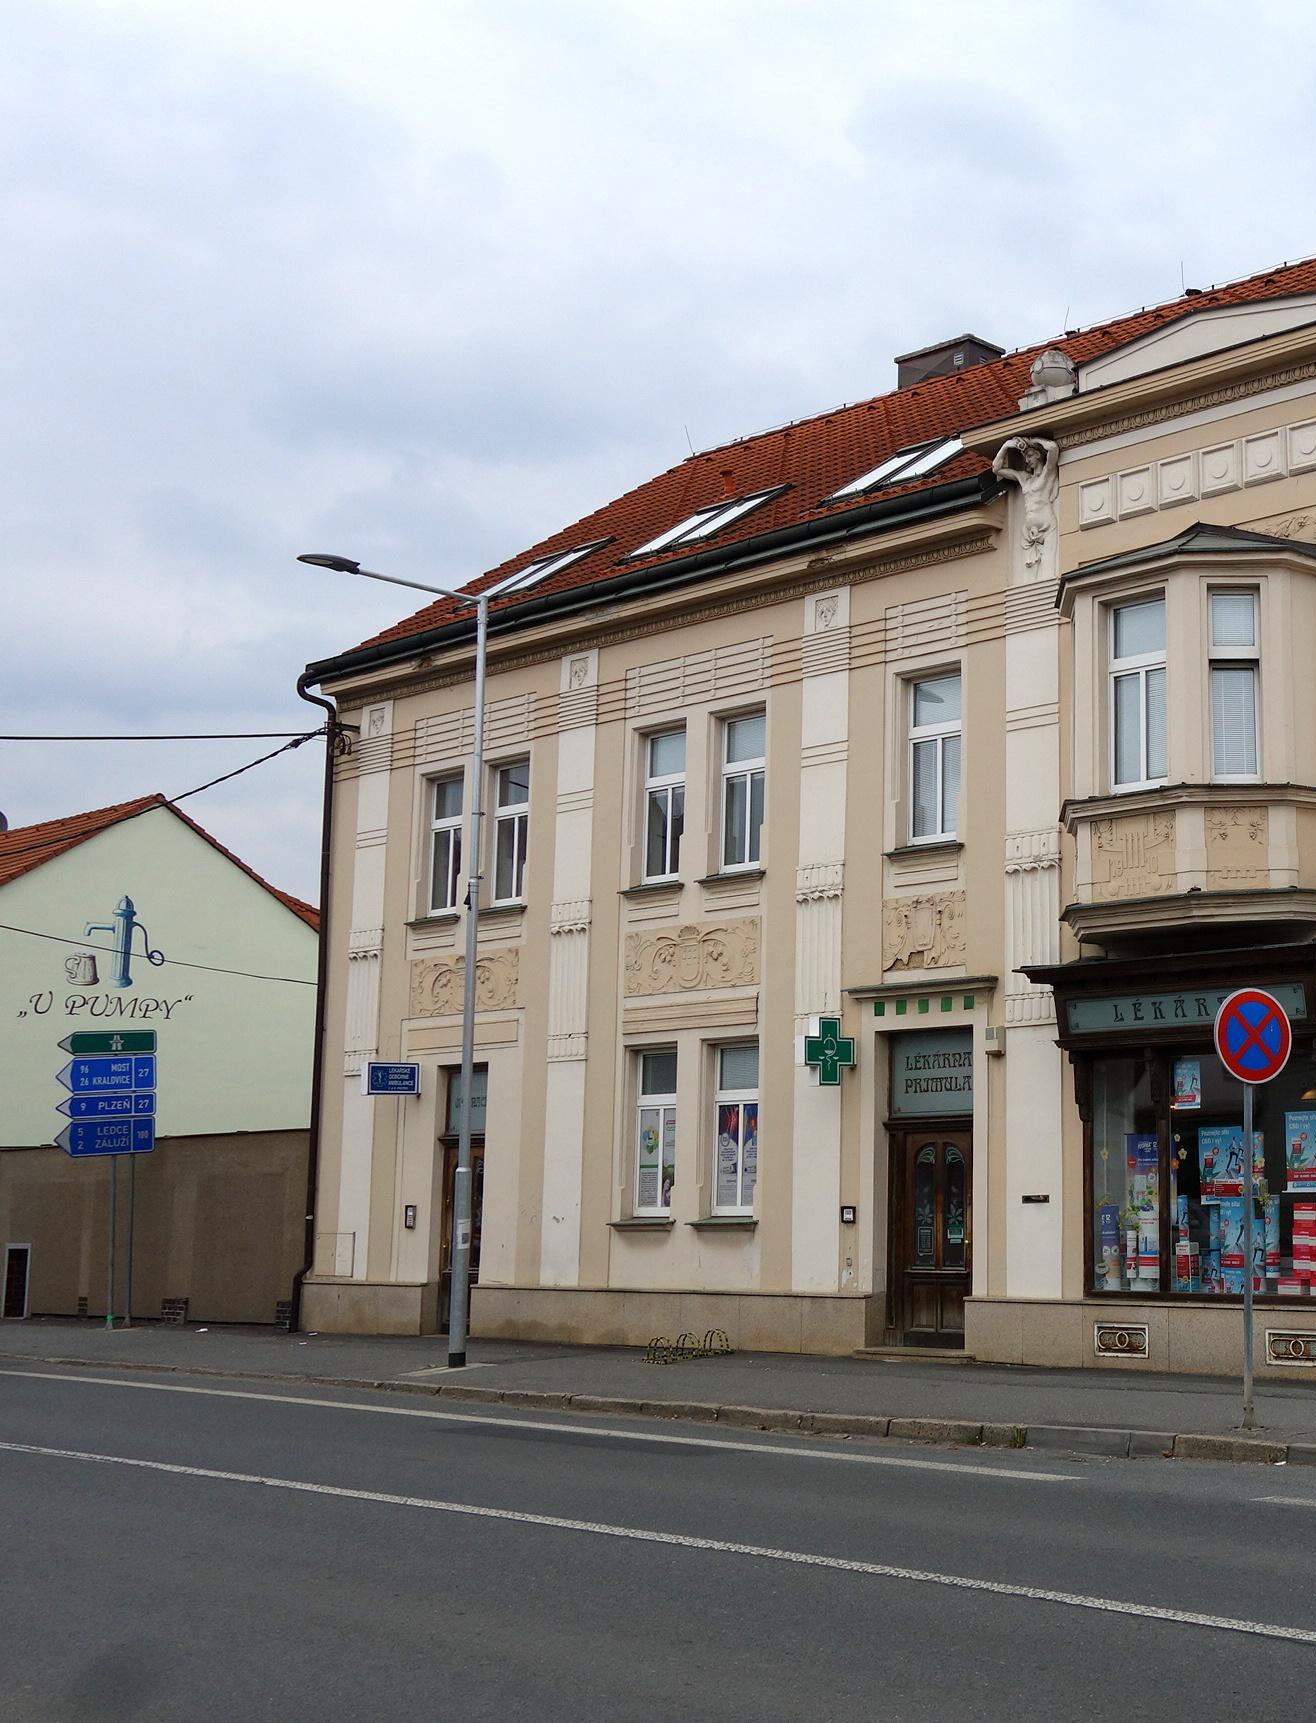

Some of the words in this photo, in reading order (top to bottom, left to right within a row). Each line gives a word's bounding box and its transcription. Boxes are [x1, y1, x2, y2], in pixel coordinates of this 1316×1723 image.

[904, 1050, 973, 1072] LÉKÁRNA
[79, 1065, 89, 1074] 96
[111, 1063, 130, 1072] MOST
[138, 1068, 149, 1078] 27
[79, 1077, 89, 1086] 26
[92, 1075, 130, 1086] KRALOVICE
[80, 1102, 87, 1112] 9
[97, 1099, 130, 1111] PLZEŇ
[138, 1100, 149, 1109] 27
[77, 1127, 84, 1136] 5
[77, 1140, 84, 1149] 2
[95, 1136, 130, 1149] ZÁLUŽÍ
